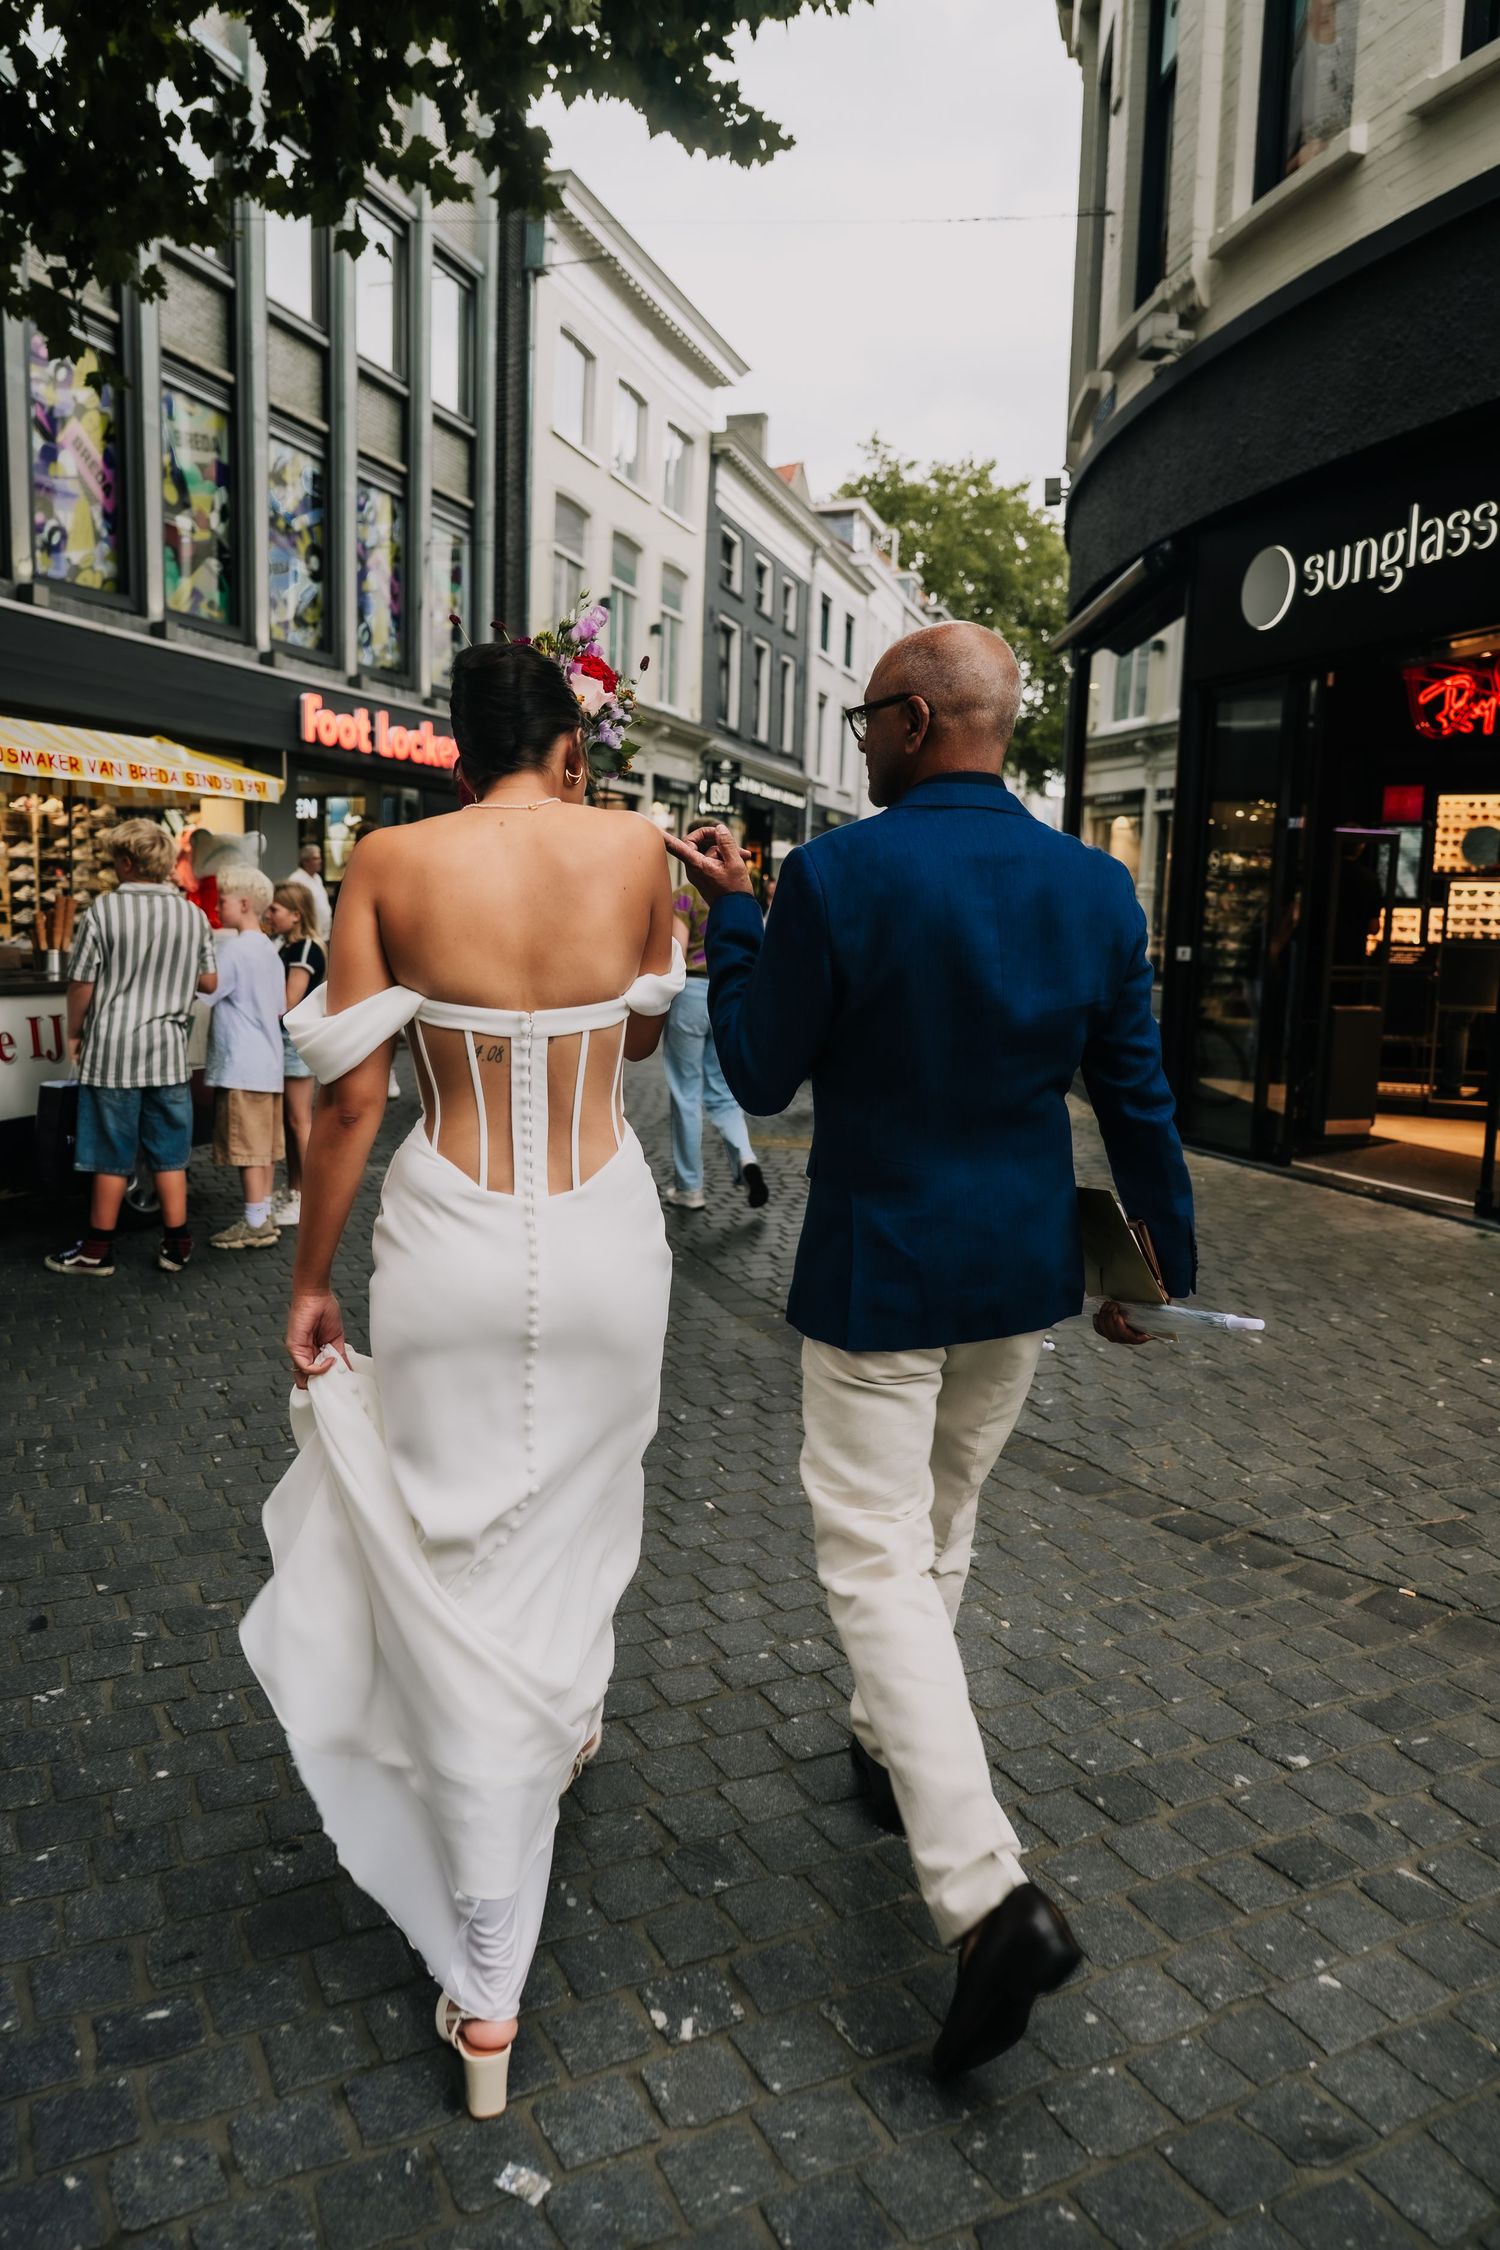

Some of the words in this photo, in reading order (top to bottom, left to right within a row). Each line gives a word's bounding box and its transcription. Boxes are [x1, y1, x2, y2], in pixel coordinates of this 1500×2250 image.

[72, 436, 113, 498] BREDA
[1303, 501, 1498, 597] sunglass
[300, 692, 372, 754] Foot
[88, 758, 122, 777] VAN
[129, 763, 179, 784] BREDA
[186, 772, 232, 790] SINDS
